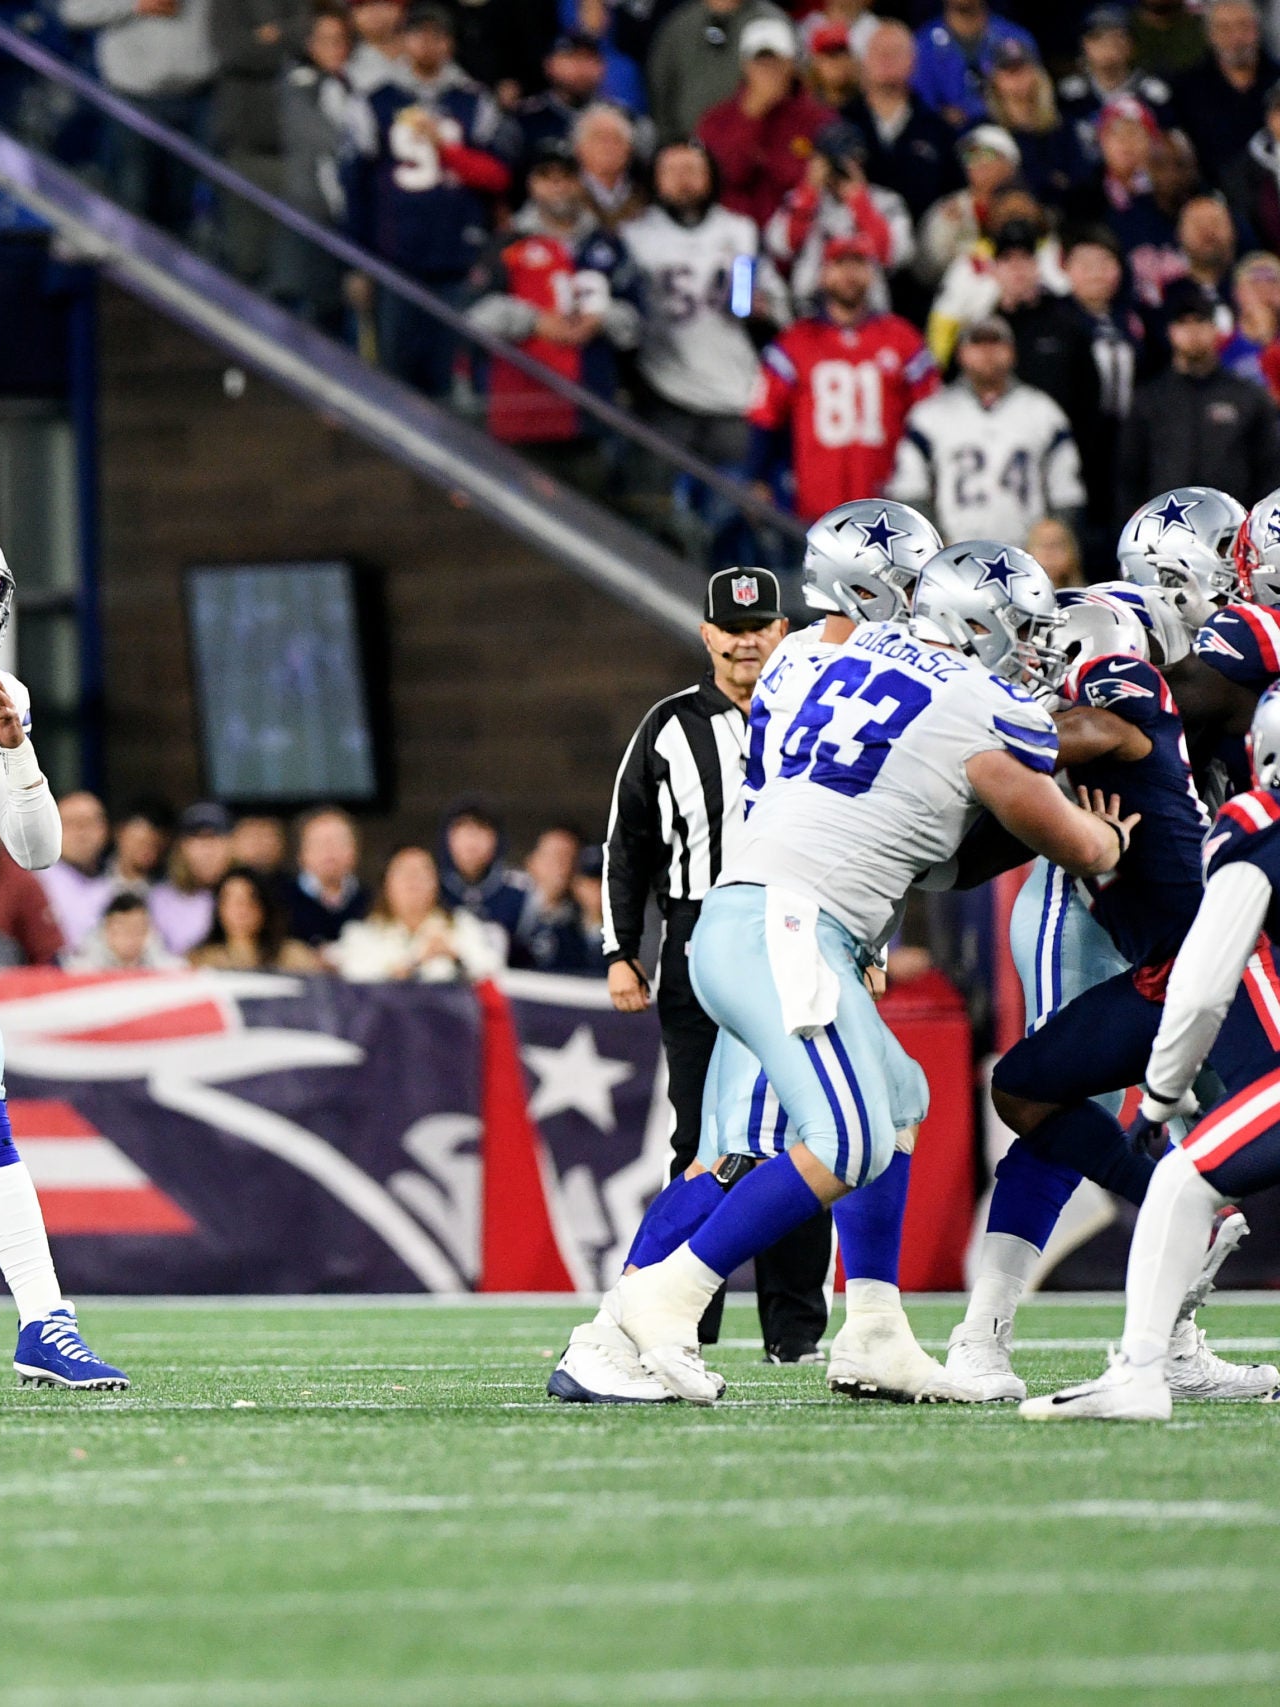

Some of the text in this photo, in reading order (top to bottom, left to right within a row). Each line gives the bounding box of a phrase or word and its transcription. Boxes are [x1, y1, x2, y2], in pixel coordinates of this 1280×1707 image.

[812, 359, 885, 438] 81
[953, 445, 1031, 508] 24
[777, 656, 933, 799] 63
